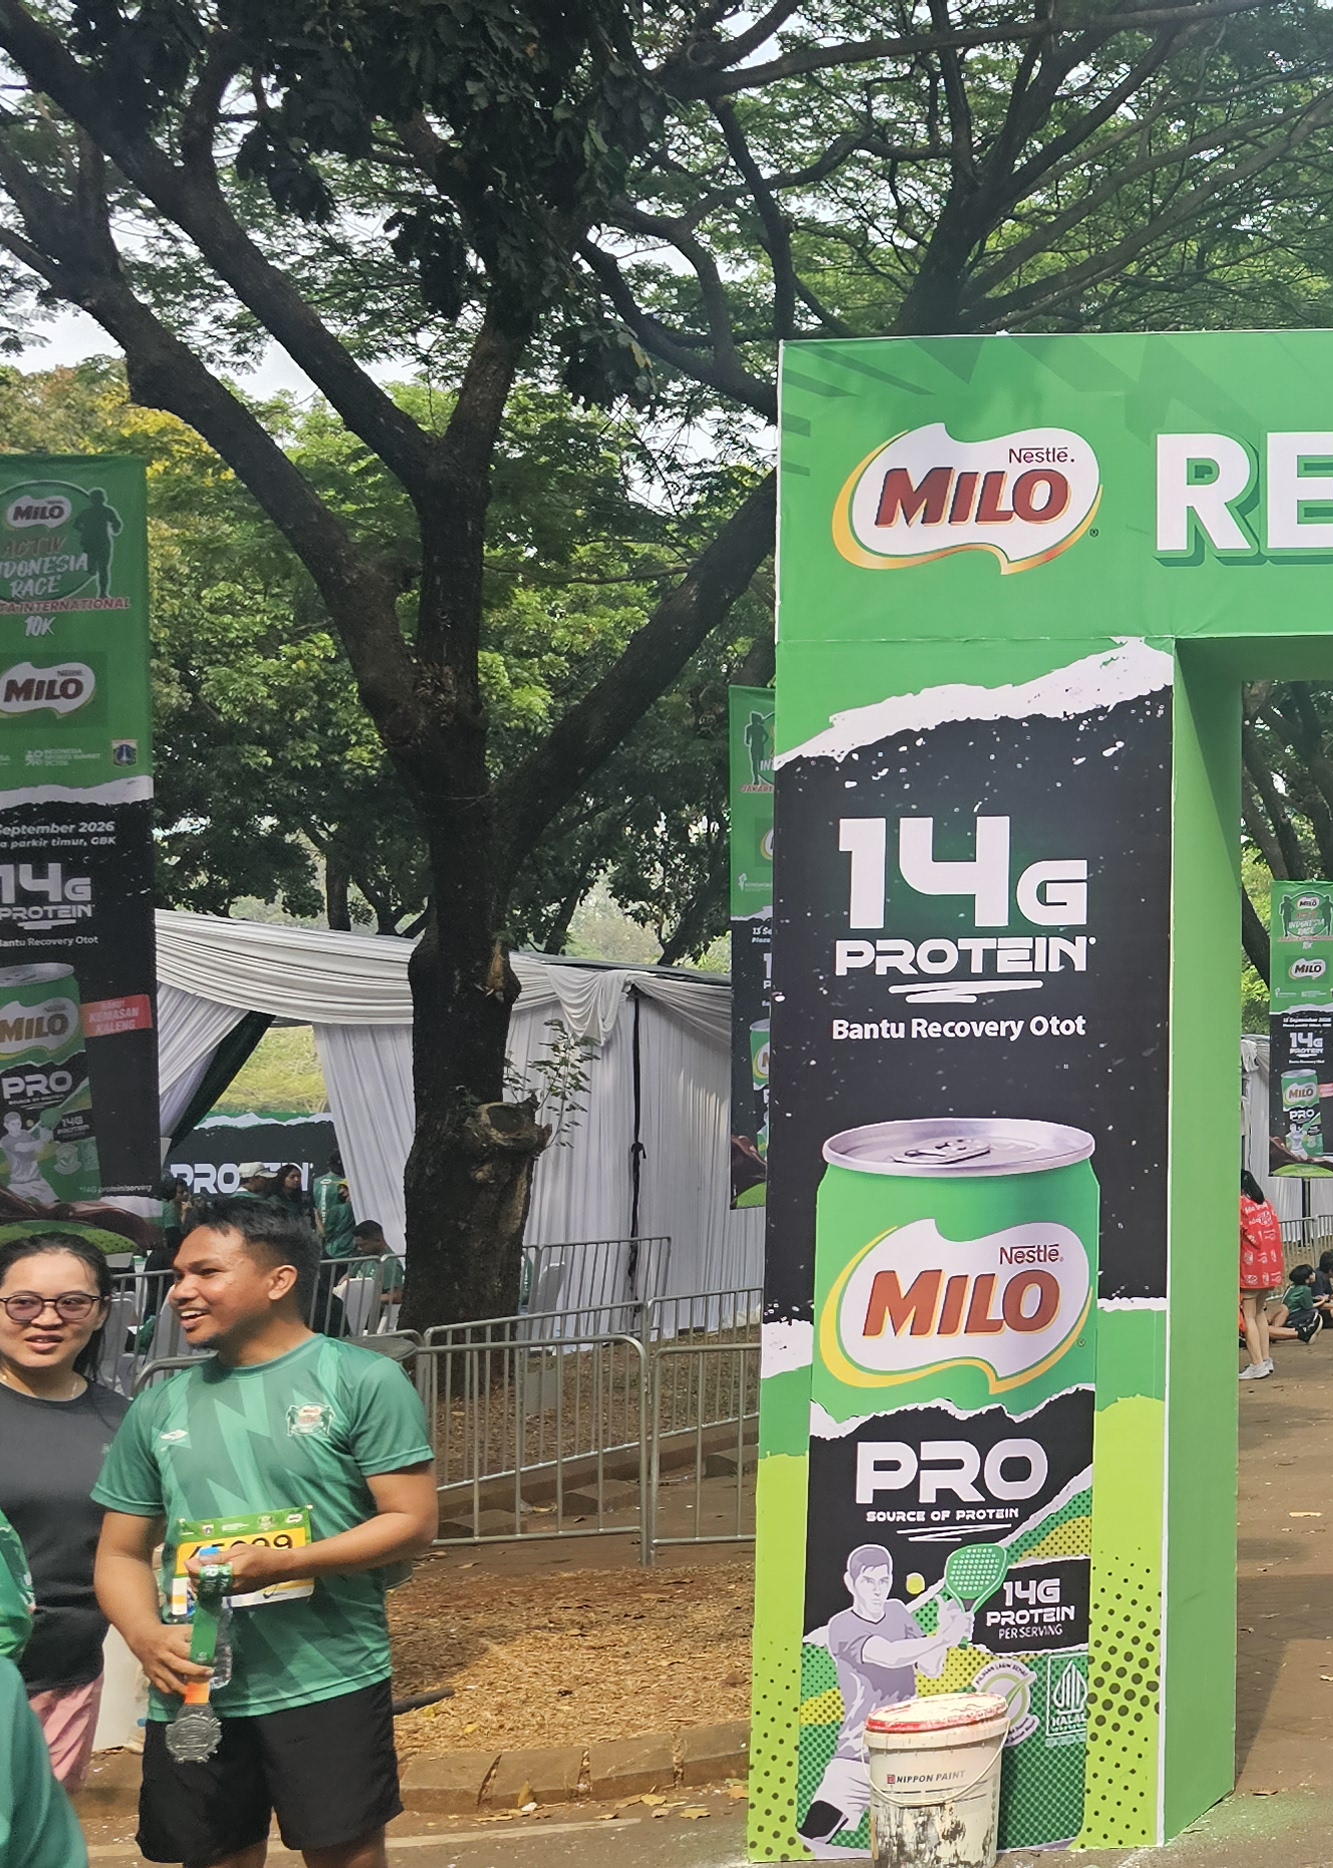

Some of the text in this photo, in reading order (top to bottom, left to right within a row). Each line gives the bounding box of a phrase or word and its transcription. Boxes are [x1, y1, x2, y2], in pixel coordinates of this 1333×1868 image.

[874, 467, 1071, 529] MILO
[12, 505, 65, 521] MILO
[10, 575, 63, 599] RACE
[24, 615, 57, 637] 10K
[3, 677, 84, 703] MILO
[78, 820, 117, 832] 2026
[10, 838, 49, 850] parkir
[51, 836, 88, 847] timur,
[91, 836, 117, 845] GBK
[839, 815, 1089, 930] 14G
[28, 936, 74, 948] Recovery
[76, 935, 100, 945] Otot
[836, 936, 1089, 977] PROTEIN
[1295, 964, 1323, 974] MILO
[0, 1013, 70, 1043] MILO
[832, 1015, 1088, 1042] Bantu Recovery Otot
[1290, 1032, 1324, 1049] 14G
[2, 1070, 73, 1101] PRO
[1289, 1088, 1314, 1099] MILO
[1290, 1109, 1315, 1121] PRO
[863, 1268, 1062, 1339] MILO
[855, 1438, 1048, 1504] PRO
[866, 1507, 1020, 1522] SOURCE OF PROTEIN
[1003, 1578, 1061, 1608] 14G
[986, 1605, 1076, 1627] PROTEIN
[998, 1623, 1064, 1640] PER SERVING
[896, 1770, 966, 1784] NIPPON PAINT
